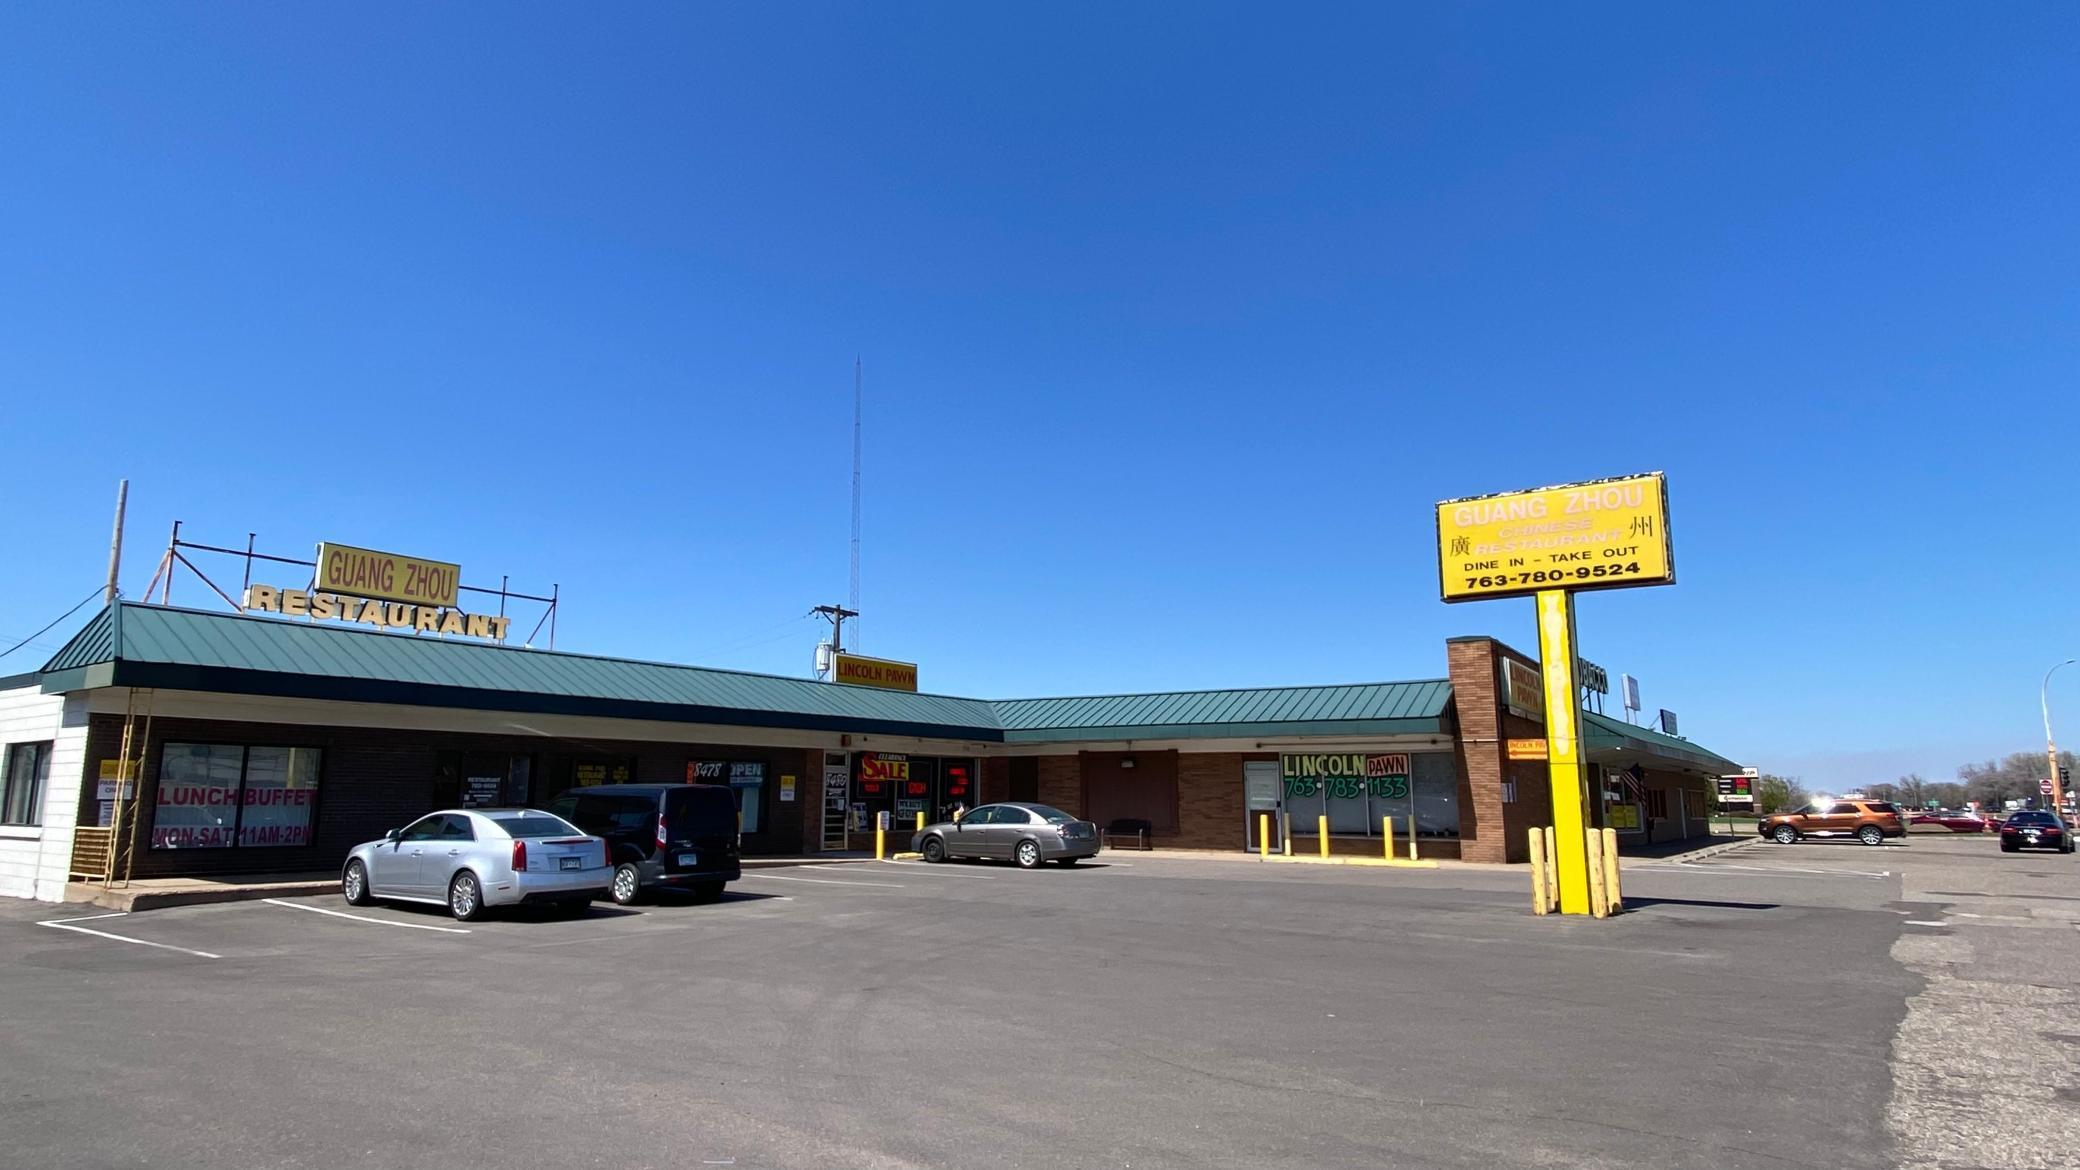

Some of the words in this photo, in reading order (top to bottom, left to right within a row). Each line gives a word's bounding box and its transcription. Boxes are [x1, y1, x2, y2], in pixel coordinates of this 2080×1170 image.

[1454, 495, 1547, 528] GUANG
[1565, 485, 1643, 515] ZHOU
[1499, 519, 1592, 539] CHINESE
[1629, 515, 1653, 540] 州
[1450, 536, 1470, 557] 廣
[1474, 529, 1622, 556] RESTAURANT
[1464, 561, 1499, 572] DINE
[1509, 558, 1524, 567] IN
[1550, 551, 1591, 563] TAKE
[1603, 546, 1639, 558] OUT
[328, 549, 394, 593] GUANG
[404, 563, 454, 601] ZHOU
[1465, 562, 1641, 589] 763-780-9524
[251, 584, 510, 639] RESTAURANT
[838, 662, 882, 680] LINCOLN
[886, 668, 915, 684] PAWN
[1578, 657, 1608, 694] OBACCO
[694, 763, 722, 777] 8478
[863, 752, 907, 780] SALE
[1284, 755, 1365, 776] LINCOLN
[1369, 757, 1404, 775] PAWN
[158, 788, 239, 806] LUNCH
[243, 788, 318, 806] BUFFET
[154, 827, 234, 844] MON-SAT
